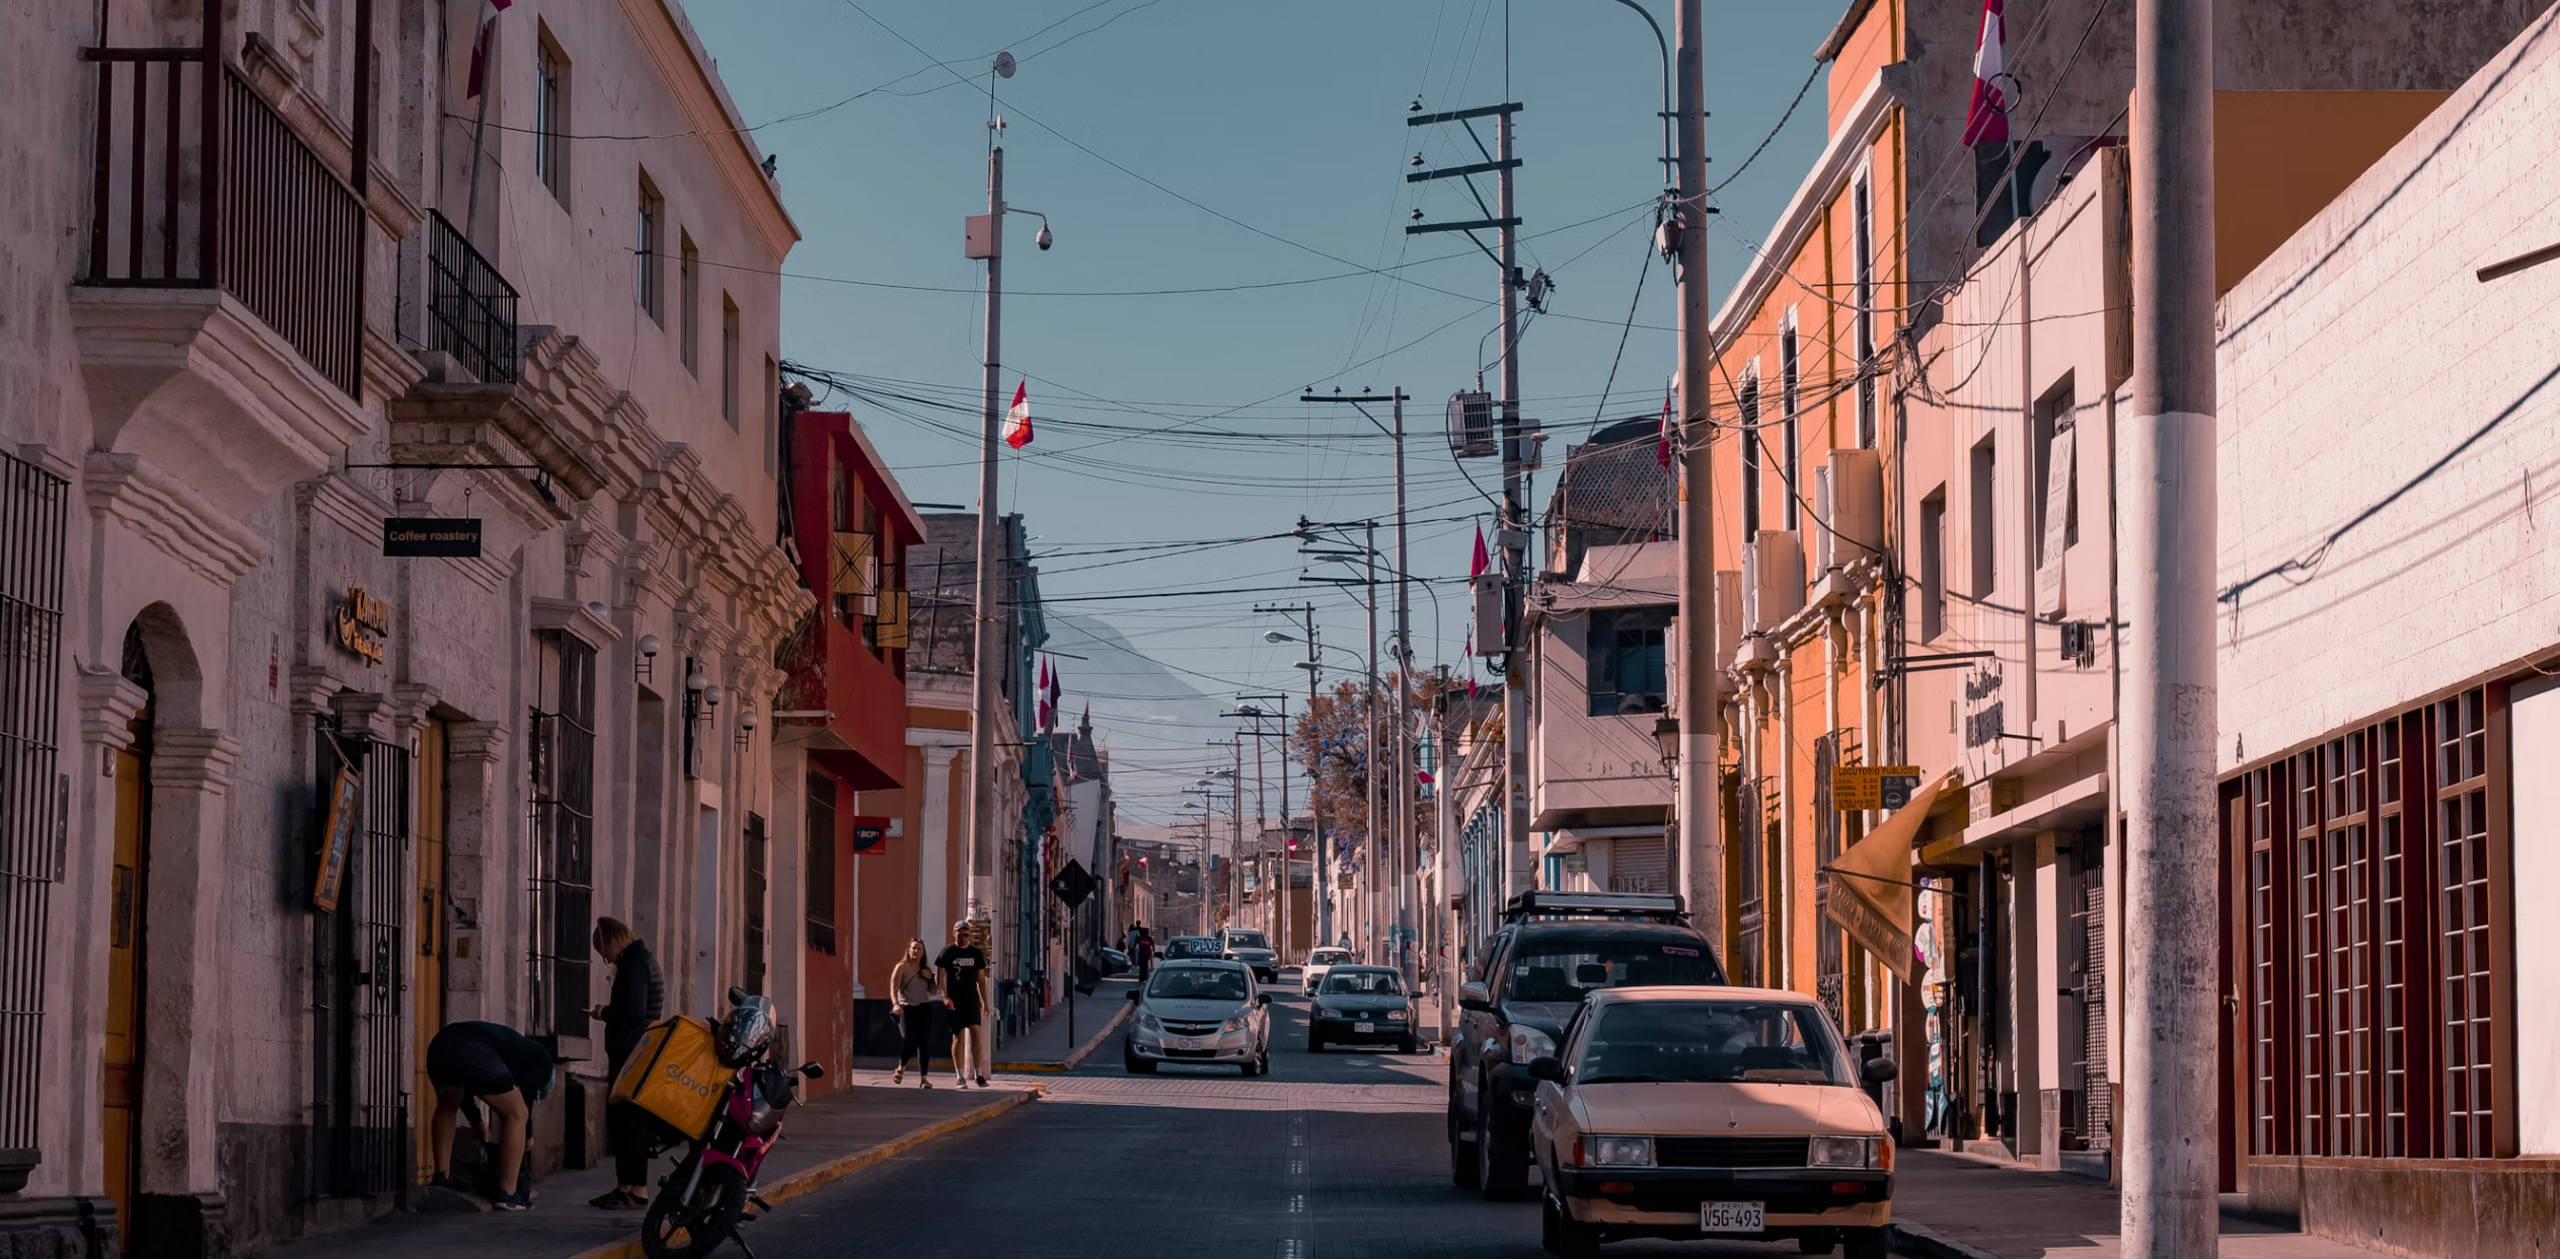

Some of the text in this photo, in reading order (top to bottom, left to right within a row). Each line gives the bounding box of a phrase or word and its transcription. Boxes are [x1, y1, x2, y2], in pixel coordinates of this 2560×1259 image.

[389, 530, 478, 543] Coffee roastery
[1881, 767, 1914, 775] PUBLICO
[860, 830, 877, 838] BCP
[1191, 939, 1223, 953] PLUS
[666, 1063, 710, 1098] Glovo
[1703, 1209, 1761, 1227] V5G-493
